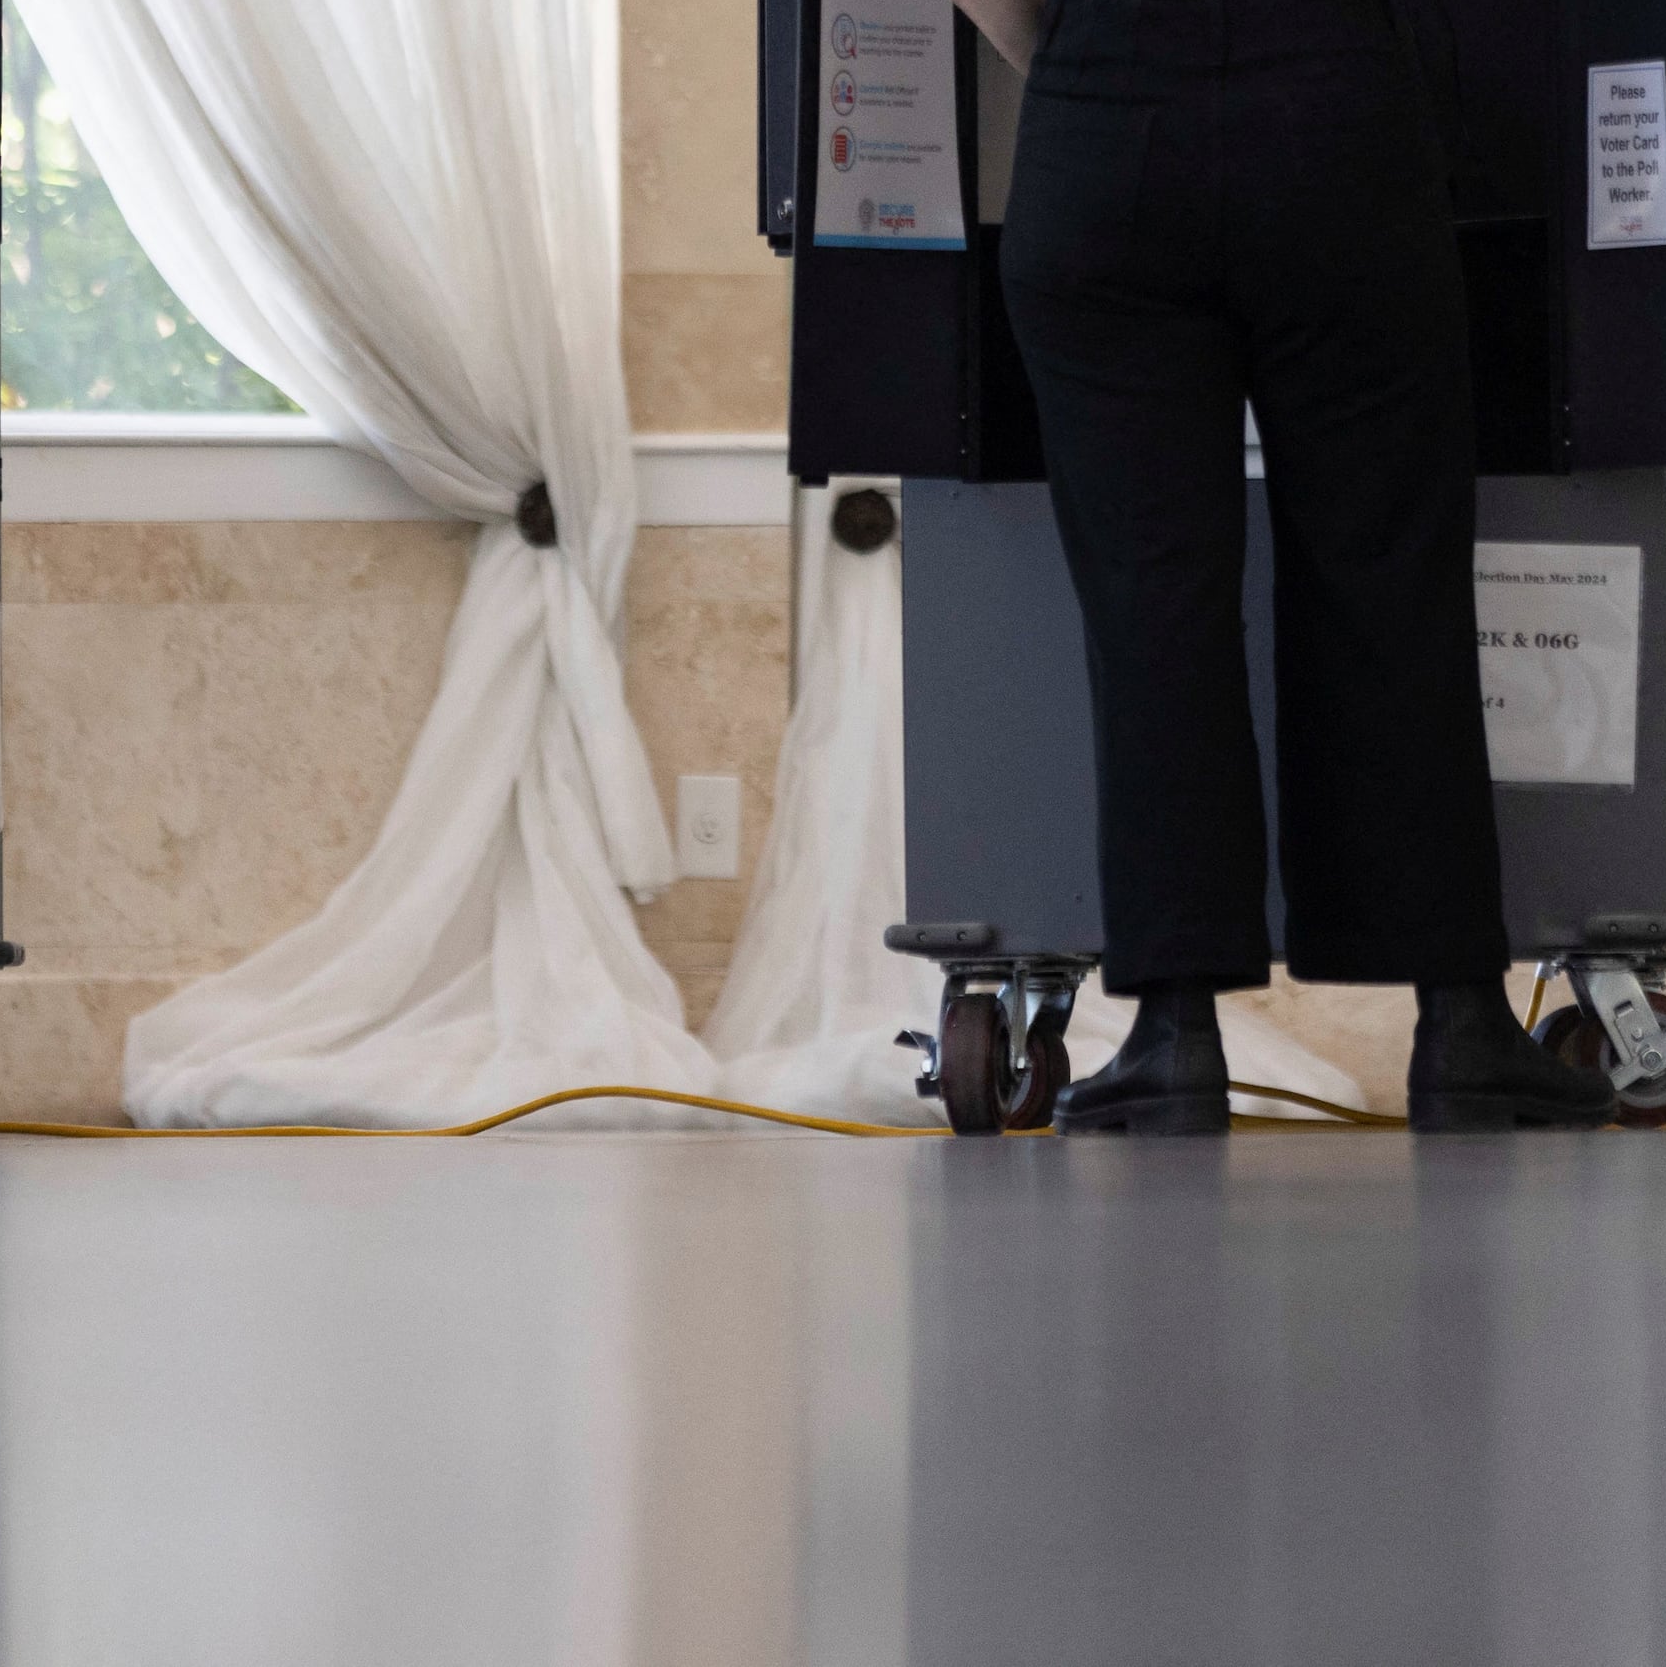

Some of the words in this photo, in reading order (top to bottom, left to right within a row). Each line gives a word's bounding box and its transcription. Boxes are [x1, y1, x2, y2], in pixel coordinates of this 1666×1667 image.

[1611, 84, 1646, 100] Please
[1599, 111, 1631, 126] return
[1633, 113, 1659, 128] your
[1600, 136, 1629, 152] Voter
[1633, 135, 1659, 150] Card
[1602, 162, 1613, 177] to
[1617, 161, 1635, 177] the
[1609, 186, 1653, 203] Worker.
[1524, 574, 1545, 584] Day
[1549, 574, 1573, 584] May
[1577, 575, 1607, 584] 2024
[1513, 633, 1529, 648] &
[1535, 634, 1580, 650] 06G
[1495, 698, 1505, 708] 4
